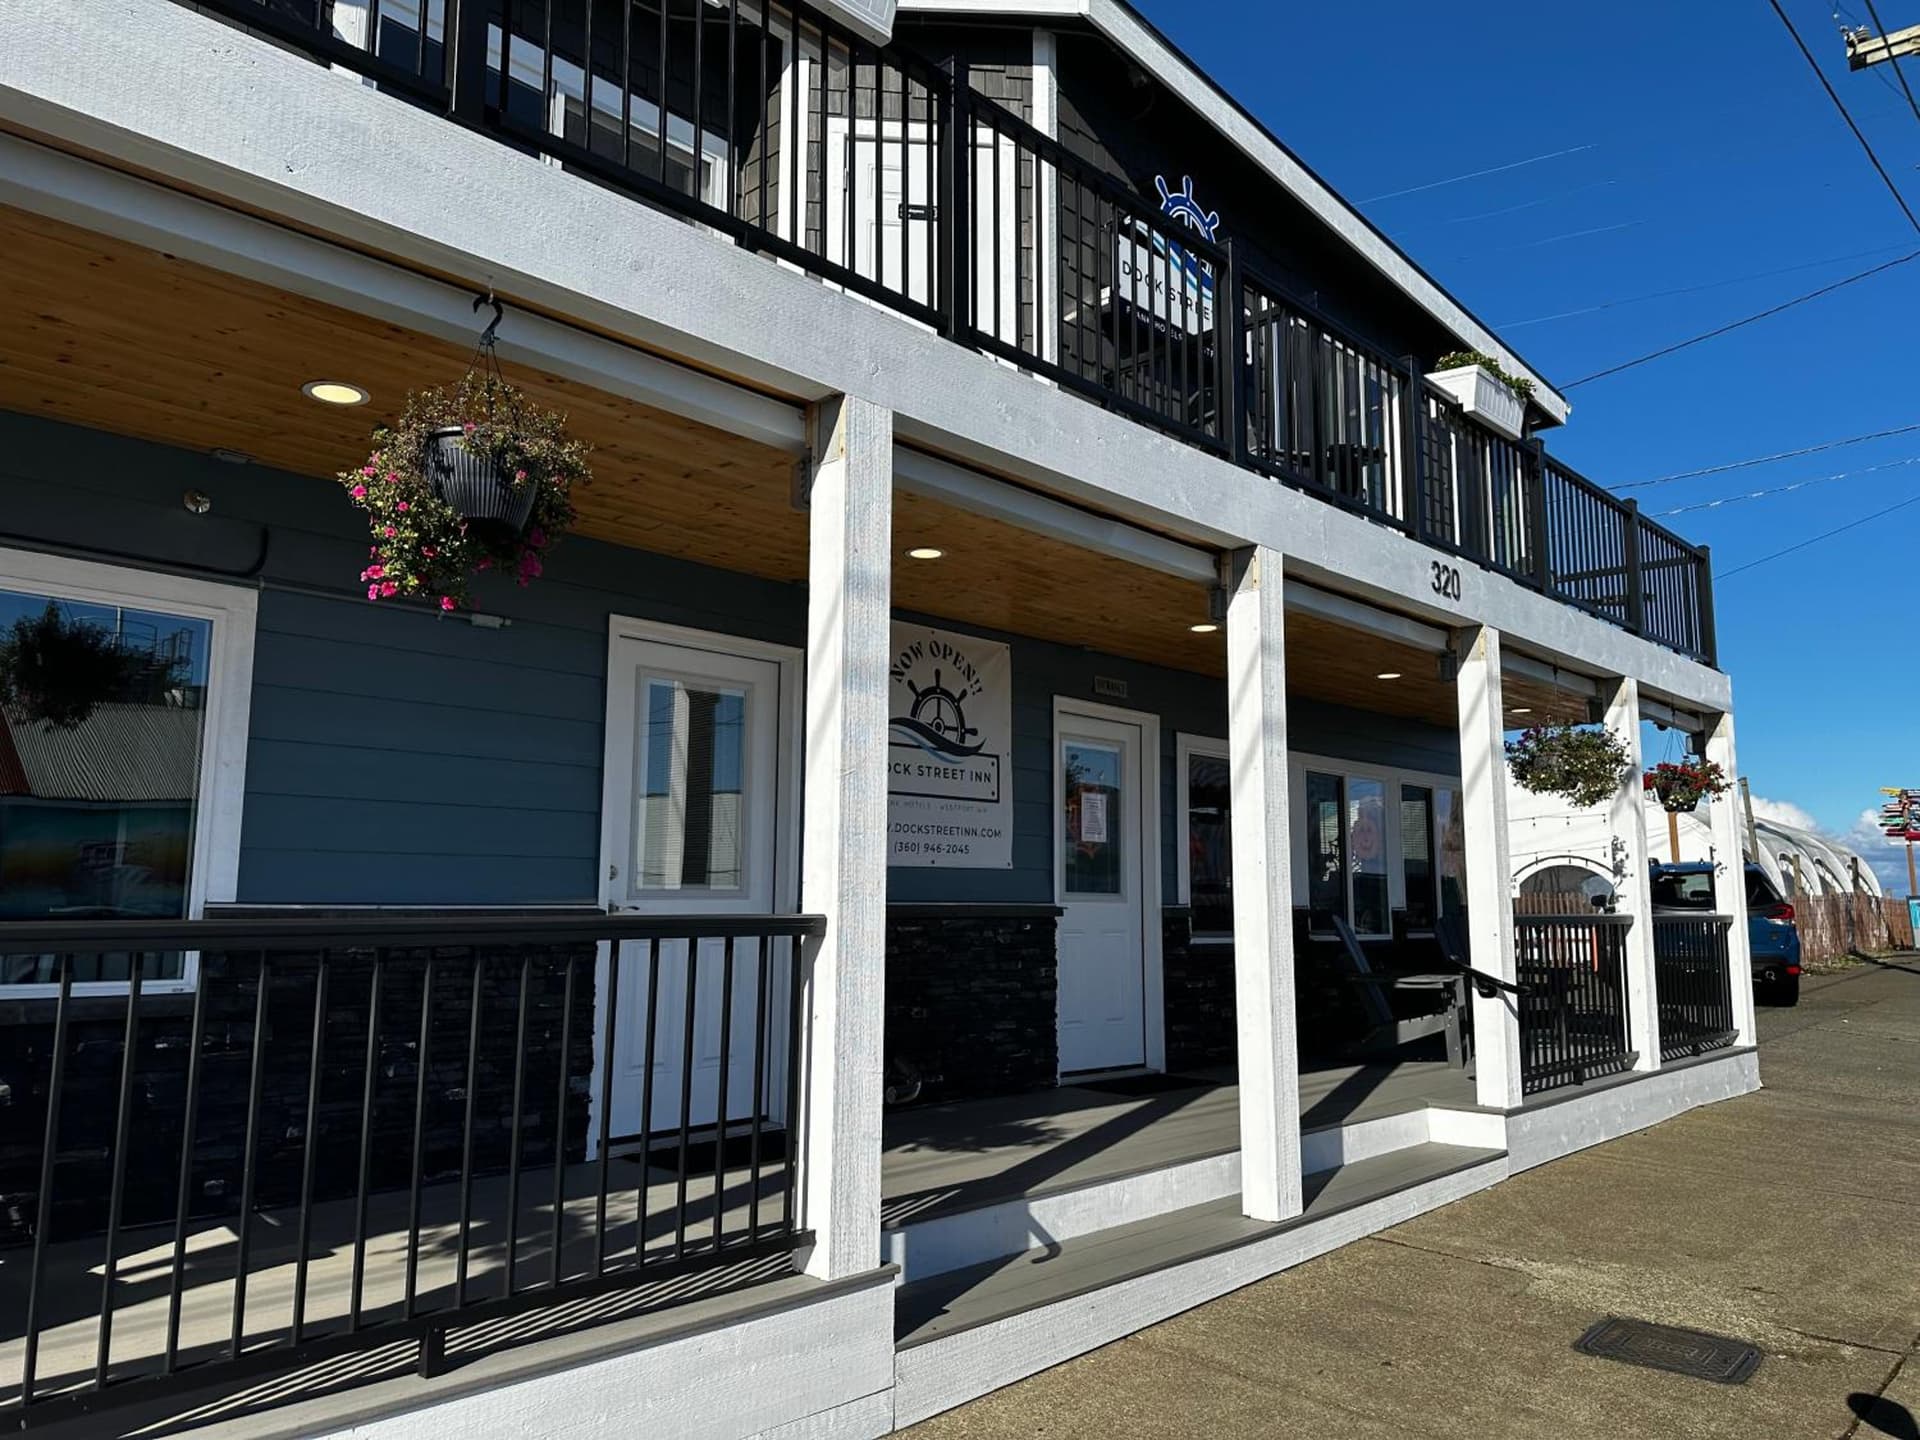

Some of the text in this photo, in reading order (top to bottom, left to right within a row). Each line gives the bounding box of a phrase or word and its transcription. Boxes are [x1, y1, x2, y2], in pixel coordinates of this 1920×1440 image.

[1431, 560, 1460, 602] 320
[889, 640, 983, 696] NOW OPEN!!
[888, 762, 992, 783] CK STREET INN
[894, 841, 970, 855] (360) 946-2045
